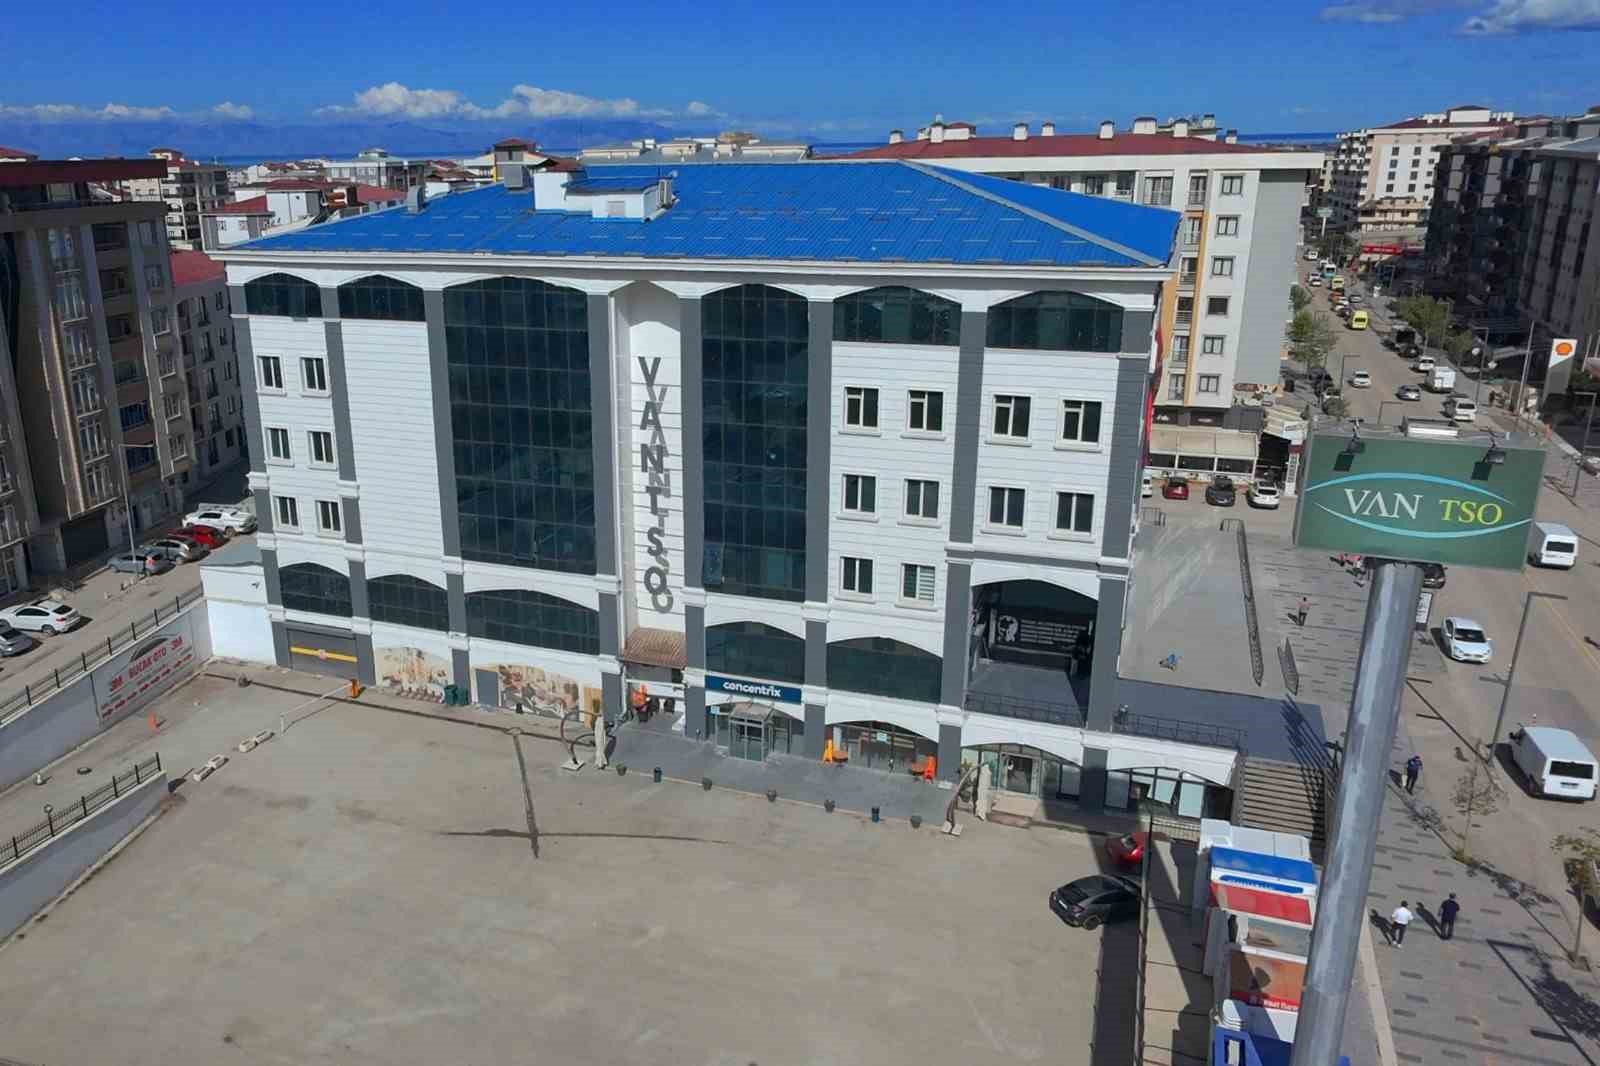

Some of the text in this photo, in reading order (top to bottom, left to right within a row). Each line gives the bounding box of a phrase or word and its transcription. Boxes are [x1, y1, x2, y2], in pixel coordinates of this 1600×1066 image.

[1343, 488, 1504, 526] VAN TSO
[722, 681, 781, 697] concentrix
